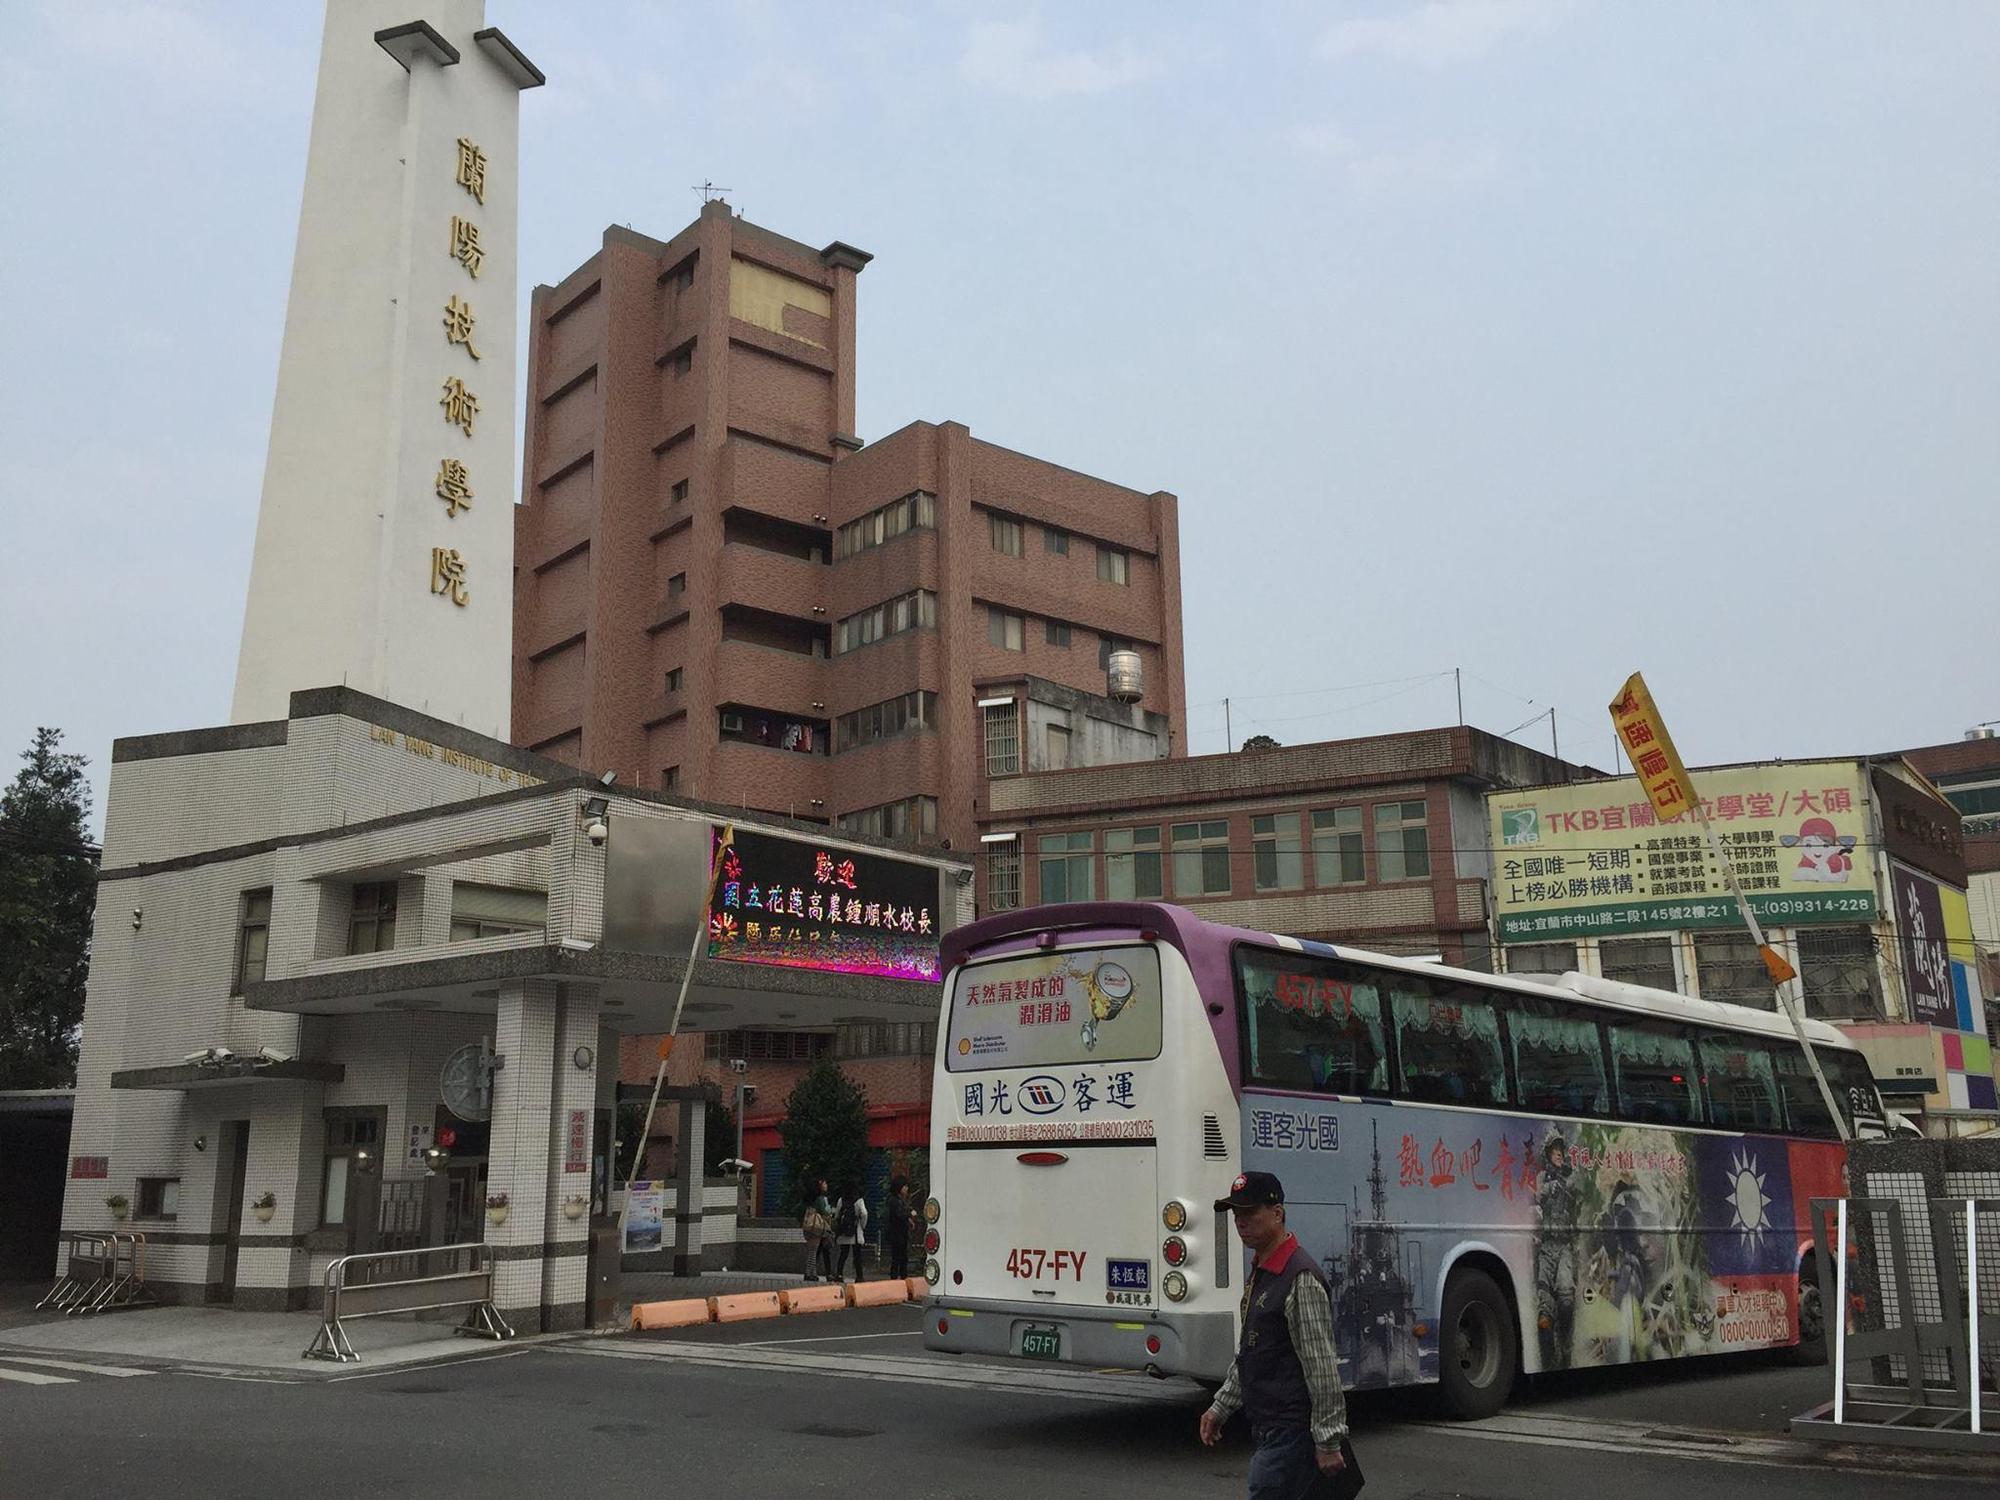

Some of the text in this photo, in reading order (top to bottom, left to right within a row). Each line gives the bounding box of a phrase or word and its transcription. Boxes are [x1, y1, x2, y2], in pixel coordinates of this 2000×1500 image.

[431, 136, 488, 608] 蘭陽技術學院
[370, 724, 396, 746] LAN
[405, 735, 433, 759] YANG
[441, 748, 494, 777] INSTITUTE
[1546, 788, 1853, 834] TKB宜蘭位學堂/大碩
[1647, 835, 1701, 851] 高普特考
[1719, 830, 1775, 846] 大學轉學
[814, 851, 857, 890] 歡迎
[1504, 849, 1630, 880] 全國唯一短期
[1648, 850, 1704, 866] 國營事業
[1650, 866, 1705, 881] 就業考試
[1506, 873, 1633, 904] 上榜必勝機構
[1651, 880, 1707, 896] 函授課程
[966, 976, 1066, 1007] 天然氣製成的
[1275, 970, 1353, 1018] 457-FY
[1019, 1001, 1072, 1026] 潤滑油
[964, 1071, 1137, 1116] 國光 客運
[1006, 1248, 1086, 1281] 457-FY
[1023, 1335, 1058, 1354] 457-FY
